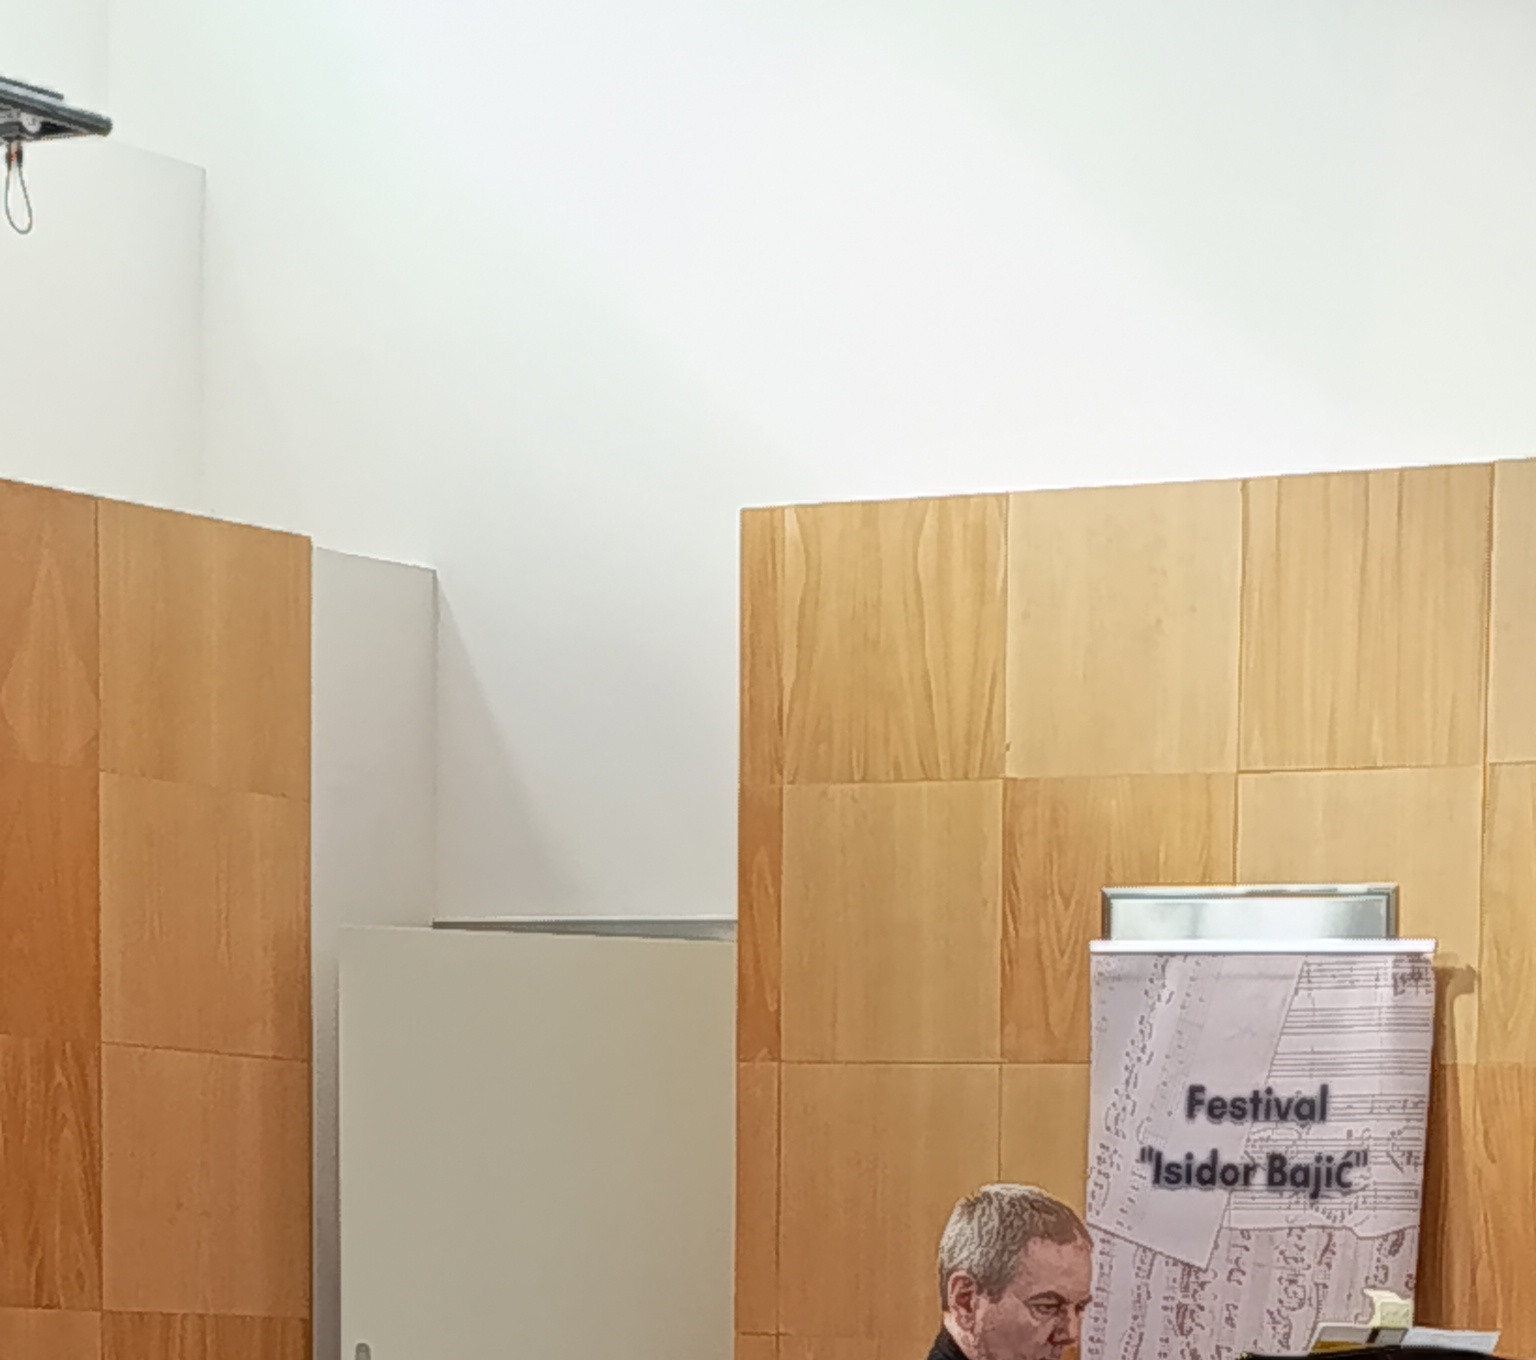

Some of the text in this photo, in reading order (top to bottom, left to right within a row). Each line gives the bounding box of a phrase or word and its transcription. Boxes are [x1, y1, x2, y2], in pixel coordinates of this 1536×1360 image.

[1185, 1083, 1329, 1123] Festival
[1141, 1146, 1369, 1201] "Isidor Bajić"
